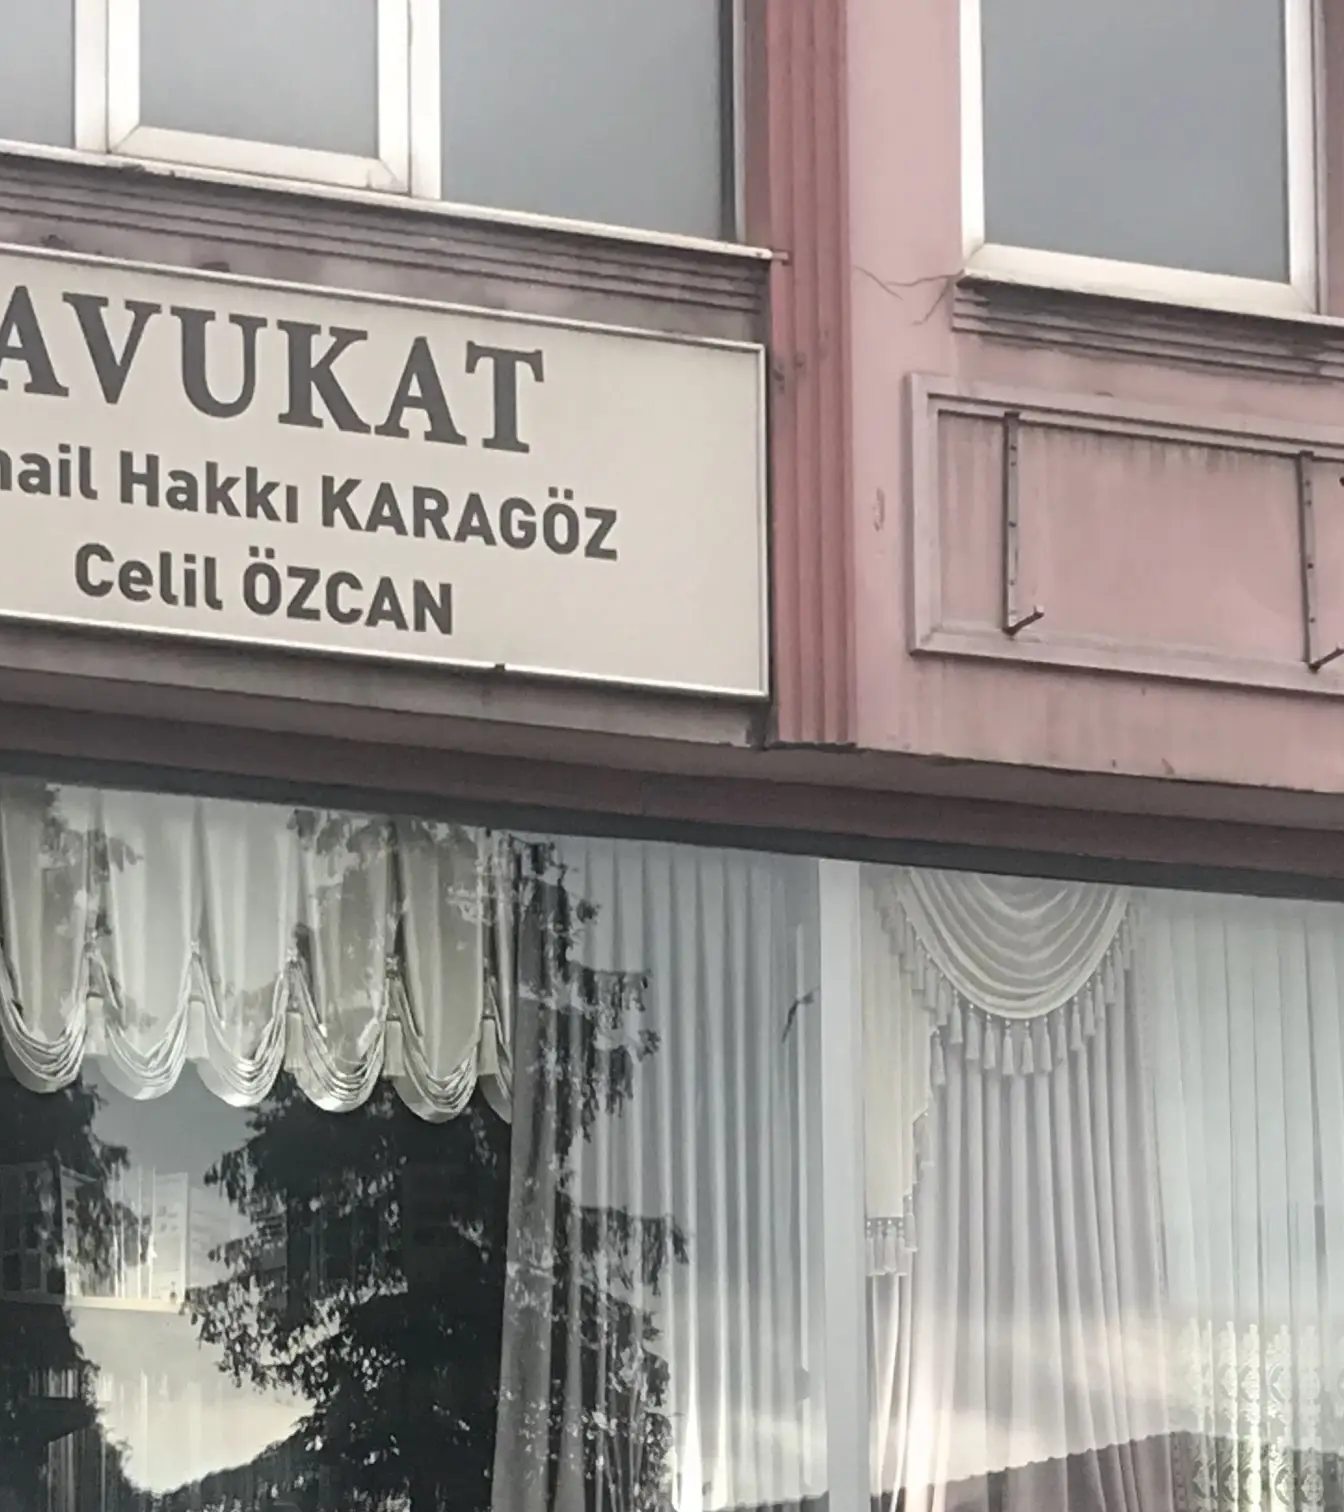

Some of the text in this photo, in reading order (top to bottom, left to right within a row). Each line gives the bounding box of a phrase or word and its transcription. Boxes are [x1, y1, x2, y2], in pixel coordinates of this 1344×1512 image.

[118, 451, 299, 524] Hakkı
[321, 475, 619, 561] KARAGÖZ
[74, 544, 454, 636] Celil ÖZCAN
